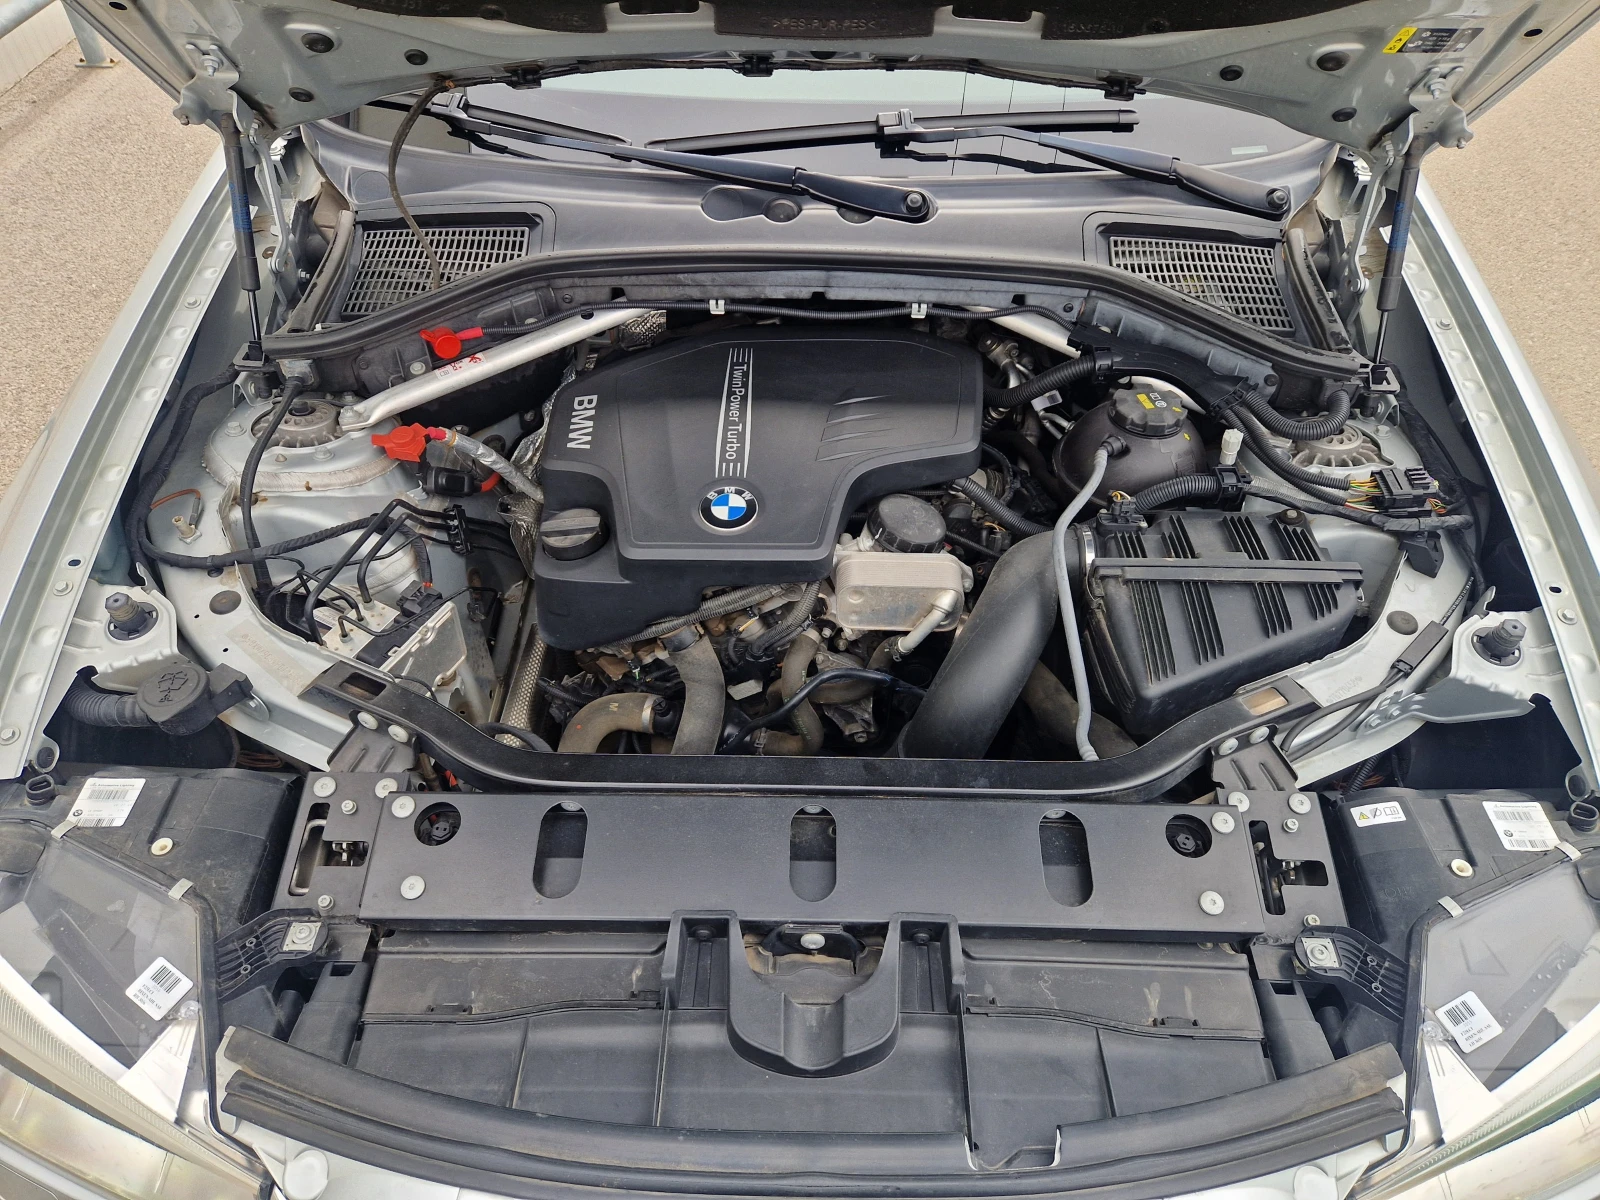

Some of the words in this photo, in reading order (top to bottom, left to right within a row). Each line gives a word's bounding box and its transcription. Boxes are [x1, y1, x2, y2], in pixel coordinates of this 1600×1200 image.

[729, 364, 747, 422] TwinPower
[566, 393, 598, 450] BMW
[725, 423, 743, 460] Turbo
[707, 486, 754, 501] BMW
